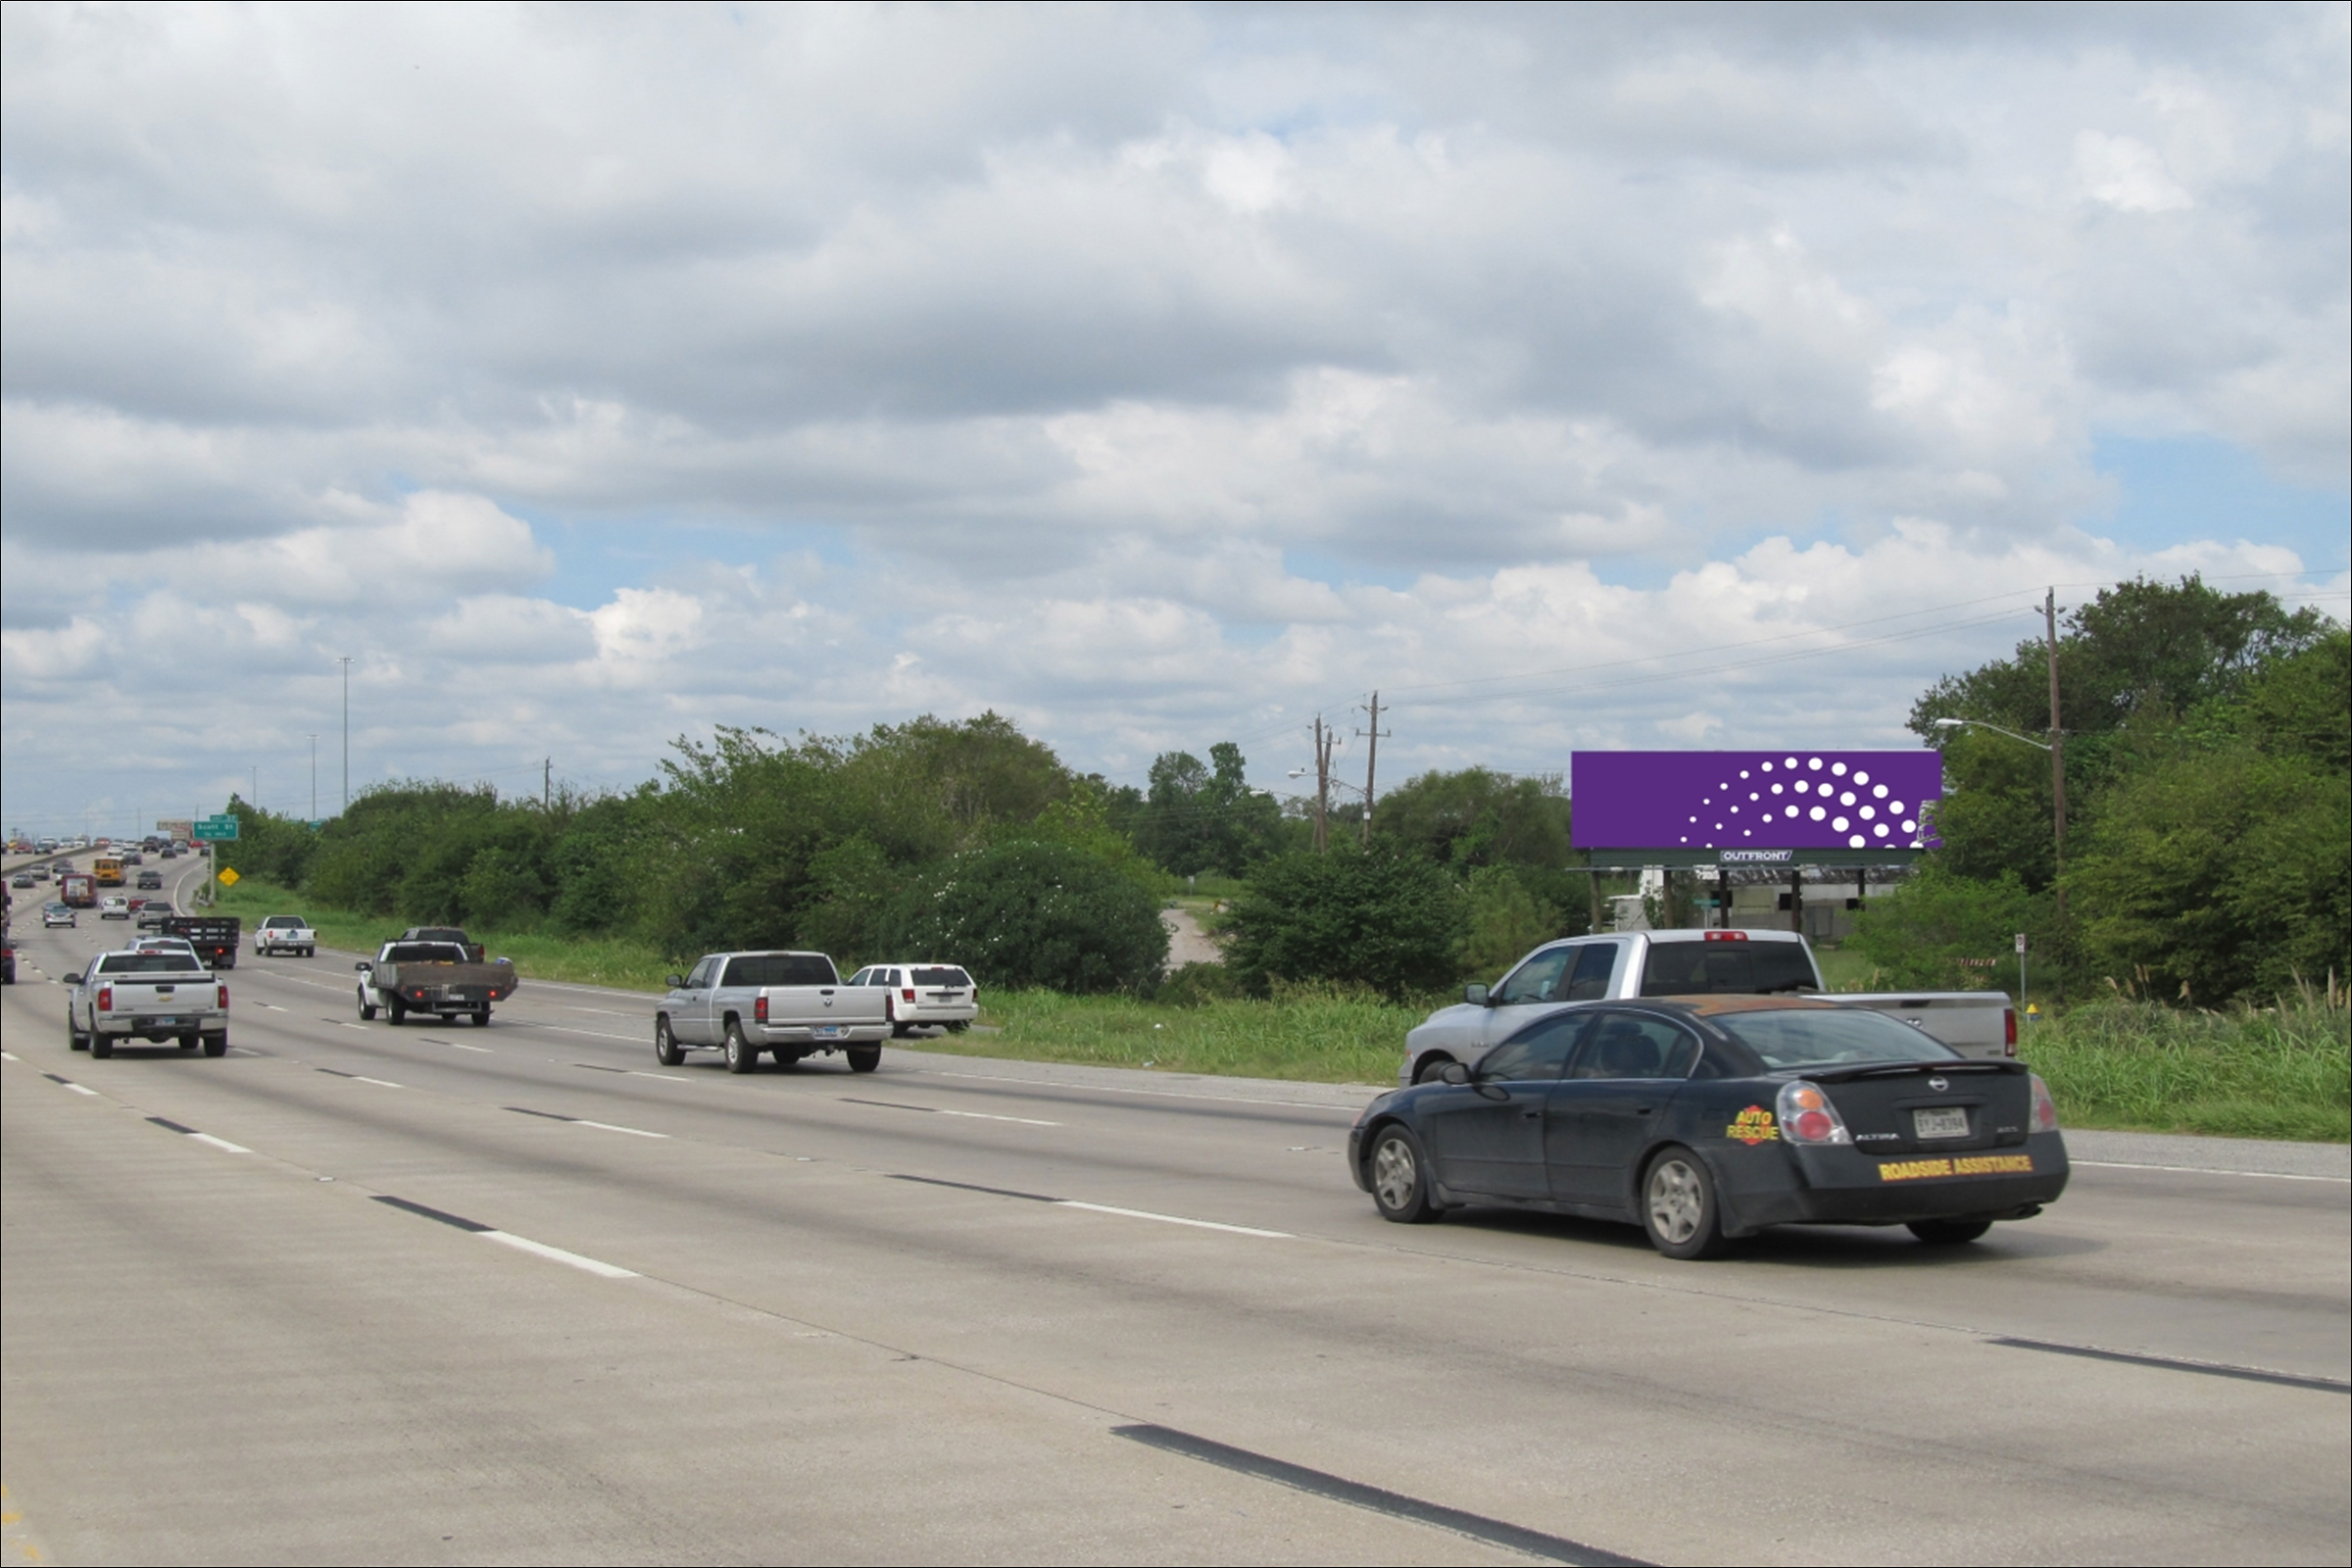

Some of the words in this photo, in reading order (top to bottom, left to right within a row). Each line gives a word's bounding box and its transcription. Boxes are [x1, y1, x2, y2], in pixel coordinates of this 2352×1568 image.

[1735, 1110, 1773, 1125] AUTO
[1726, 1124, 1780, 1140] RESCUE
[1878, 1158, 1953, 1182] ROADSIDE
[1953, 1154, 2034, 1175] ASSISTANCE
